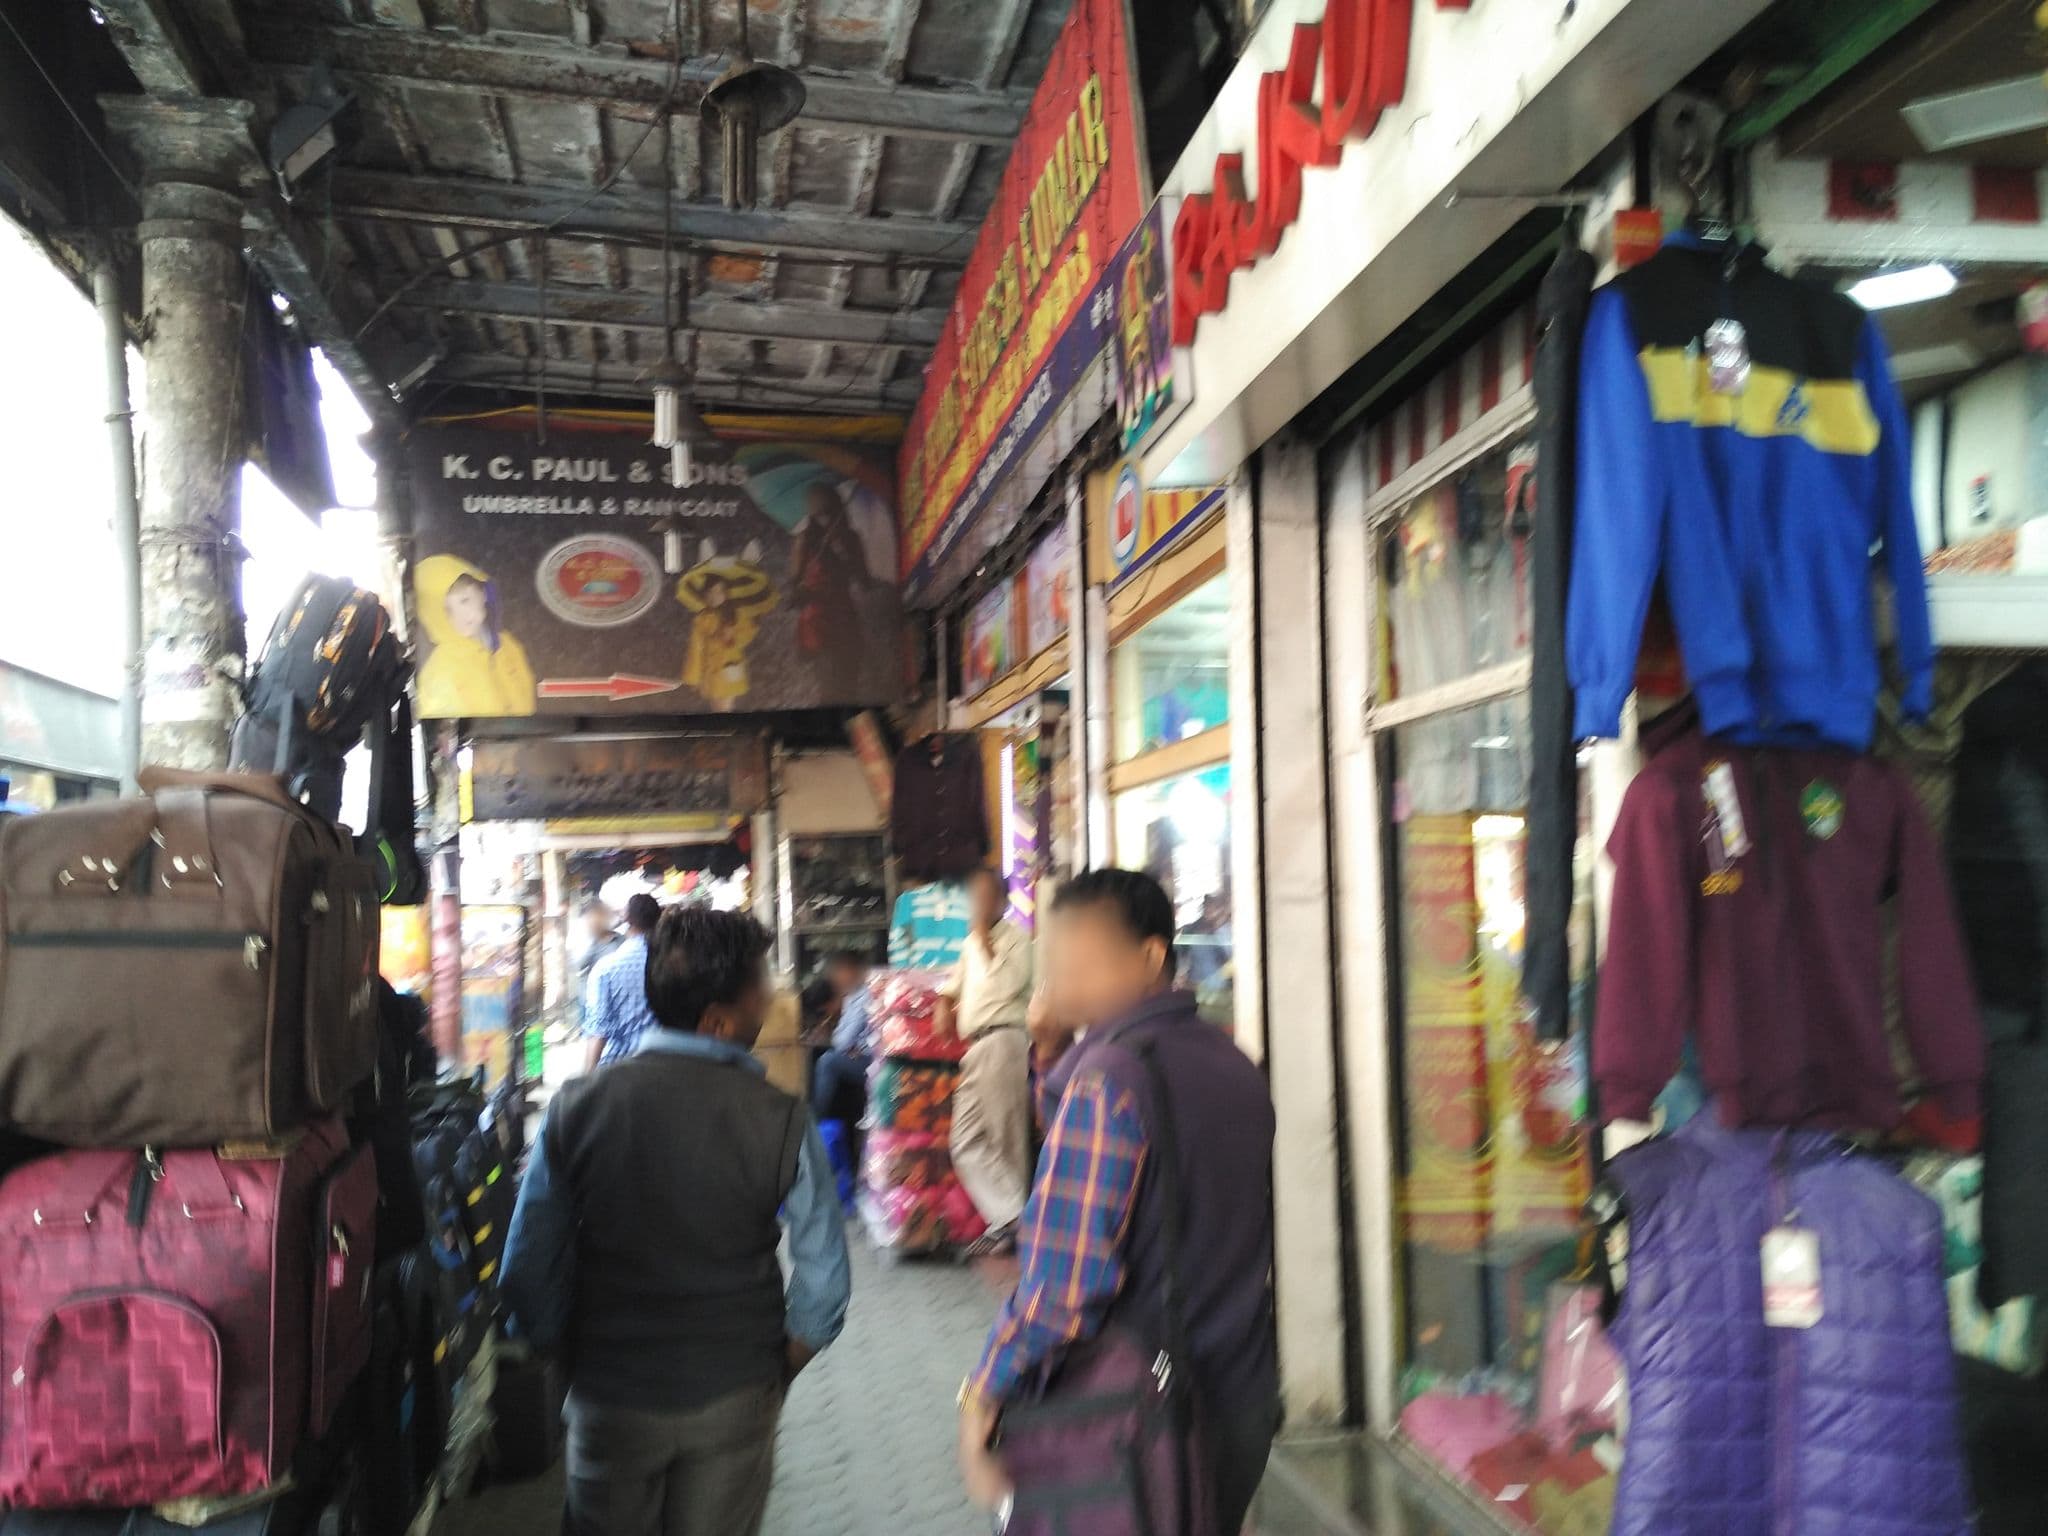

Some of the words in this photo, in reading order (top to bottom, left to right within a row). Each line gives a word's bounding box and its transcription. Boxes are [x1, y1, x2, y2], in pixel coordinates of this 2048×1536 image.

[443, 455, 480, 480] K.
[488, 456, 524, 481] C.
[532, 457, 619, 483] PAUL
[627, 460, 652, 484] &
[463, 495, 595, 515] UMBRELLA
[600, 497, 619, 516] &
